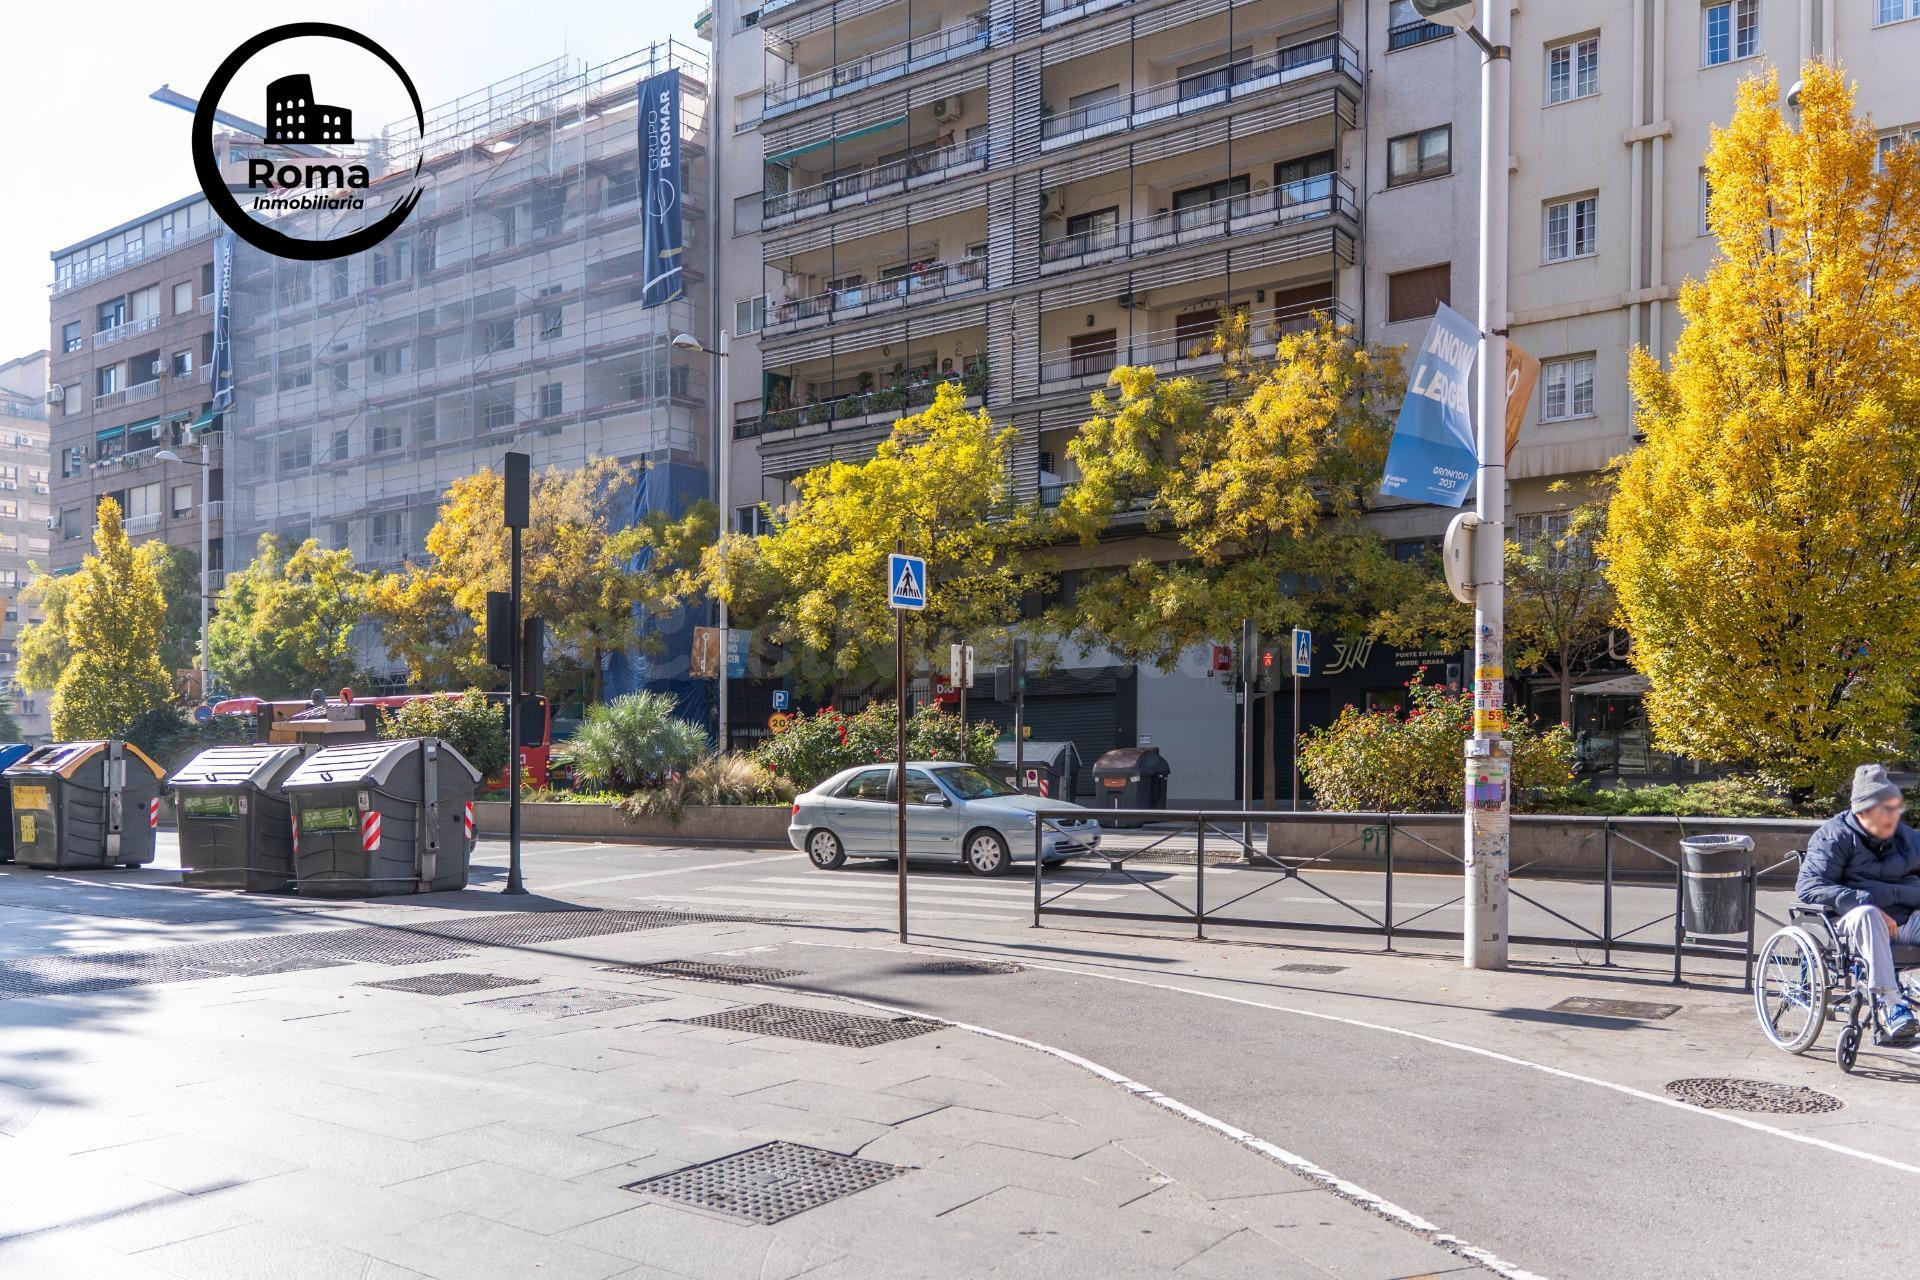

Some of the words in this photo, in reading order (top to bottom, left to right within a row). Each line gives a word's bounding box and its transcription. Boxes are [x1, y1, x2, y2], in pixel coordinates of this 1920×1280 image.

[648, 110, 659, 171] GRUPO
[659, 89, 671, 169] PROMAR
[222, 248, 232, 308] PROMAR
[1428, 324, 1475, 375] KNOW
[1438, 478, 1456, 489] 2031
[772, 719, 786, 728] 20
[775, 692, 785, 707] P
